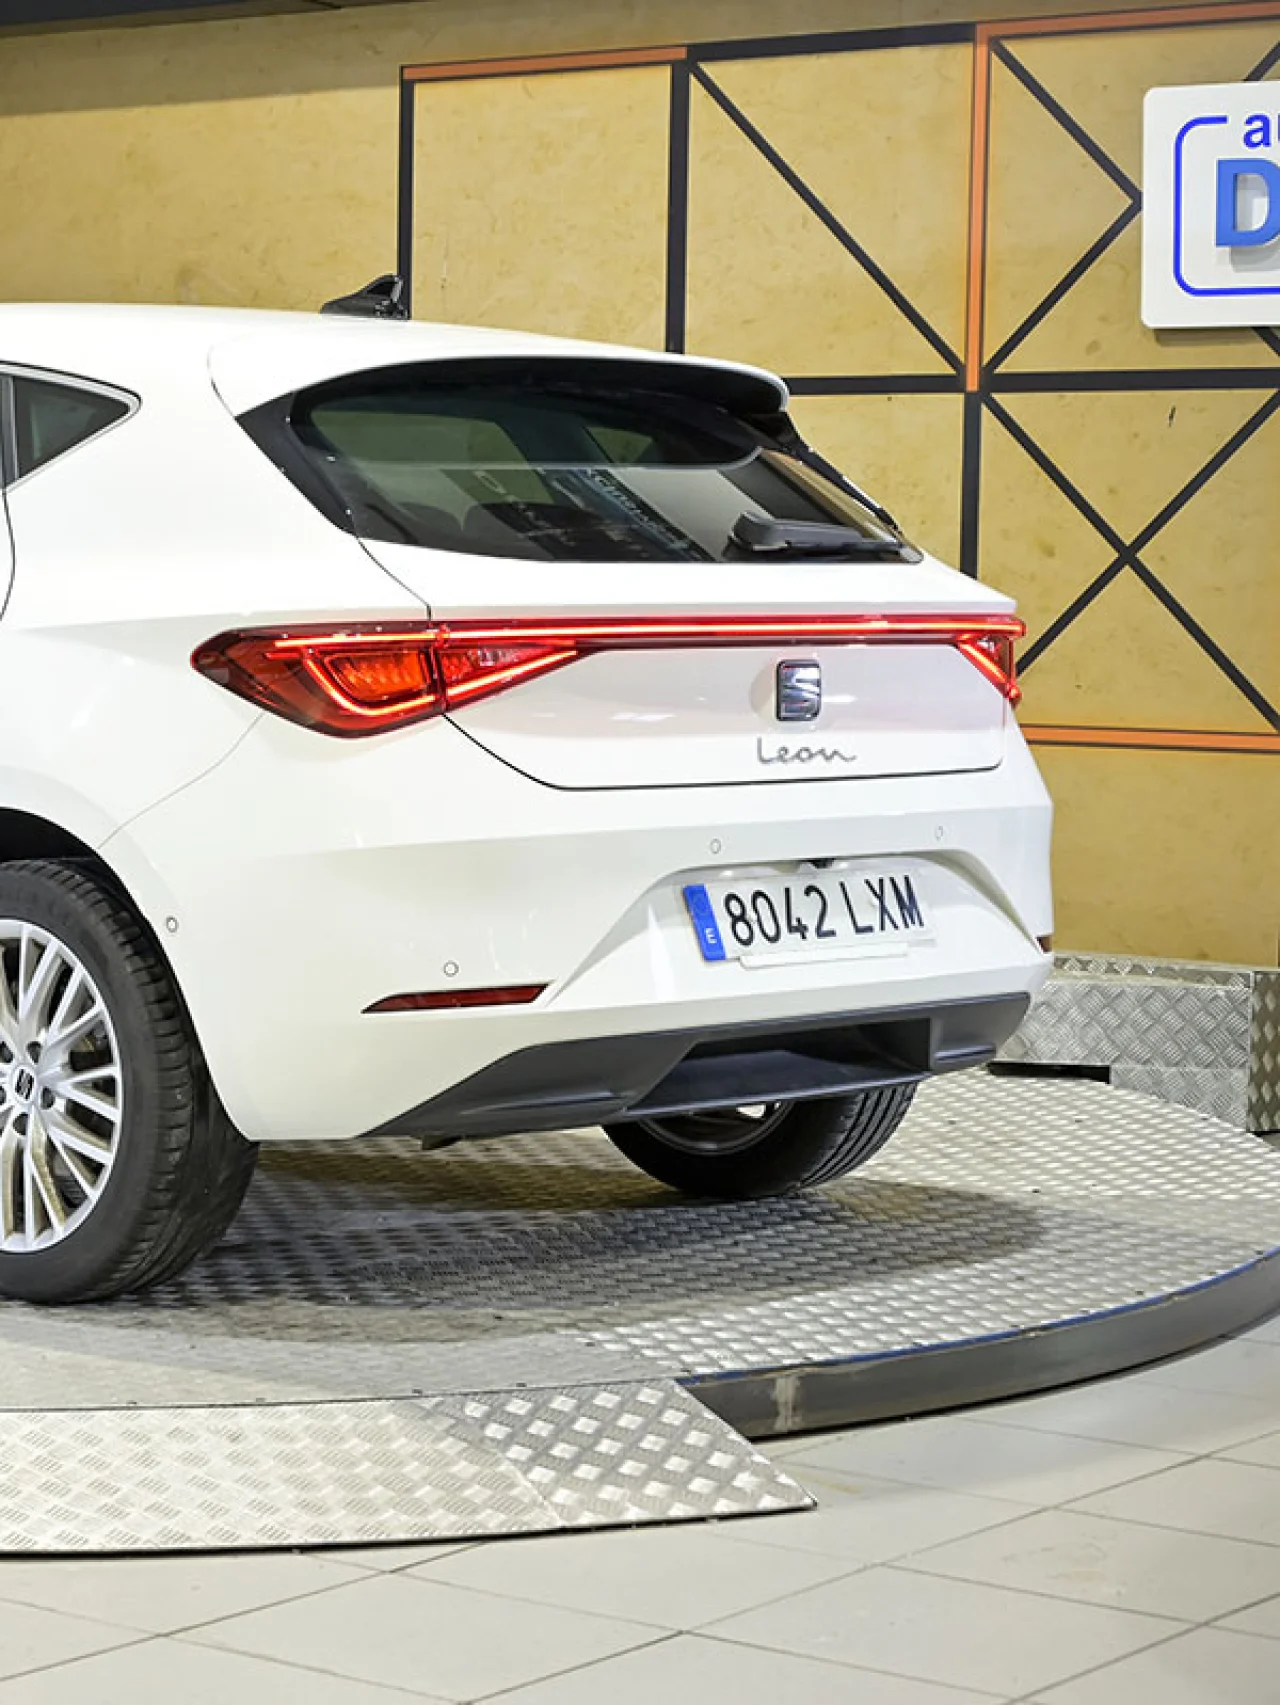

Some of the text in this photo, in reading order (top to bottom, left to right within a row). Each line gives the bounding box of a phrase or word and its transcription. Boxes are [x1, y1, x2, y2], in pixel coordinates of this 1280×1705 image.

[1242, 114, 1280, 149] a
[756, 736, 857, 764] Leon
[724, 874, 924, 946] 8042 LXM
[704, 927, 717, 944] E
